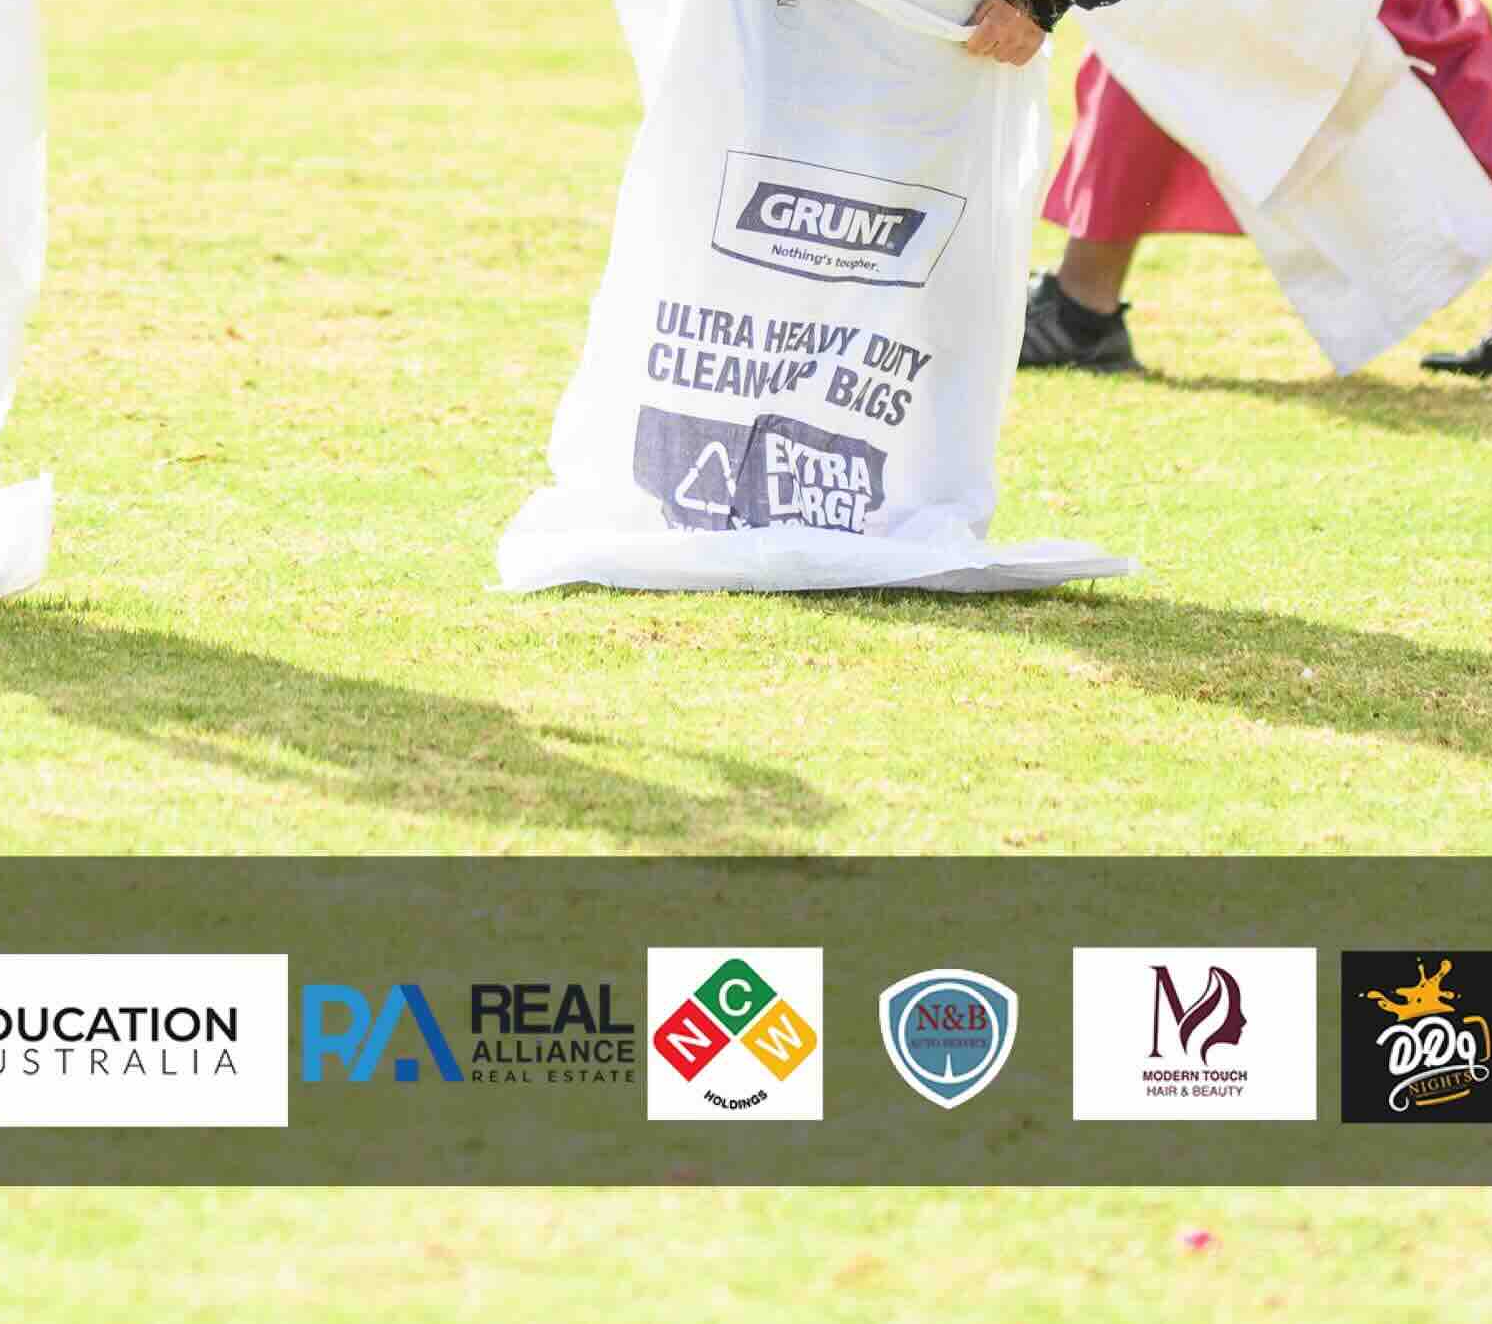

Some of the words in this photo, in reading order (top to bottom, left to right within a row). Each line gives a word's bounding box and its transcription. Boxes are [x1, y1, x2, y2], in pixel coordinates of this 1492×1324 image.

[760, 193, 903, 247] GRUNT
[771, 244, 833, 266] Nothing's
[656, 300, 754, 349] ULTRA
[763, 319, 861, 355] HEAVY
[862, 333, 932, 382] DUTY
[824, 365, 912, 427] BAGS
[766, 432, 873, 497] EXTRA
